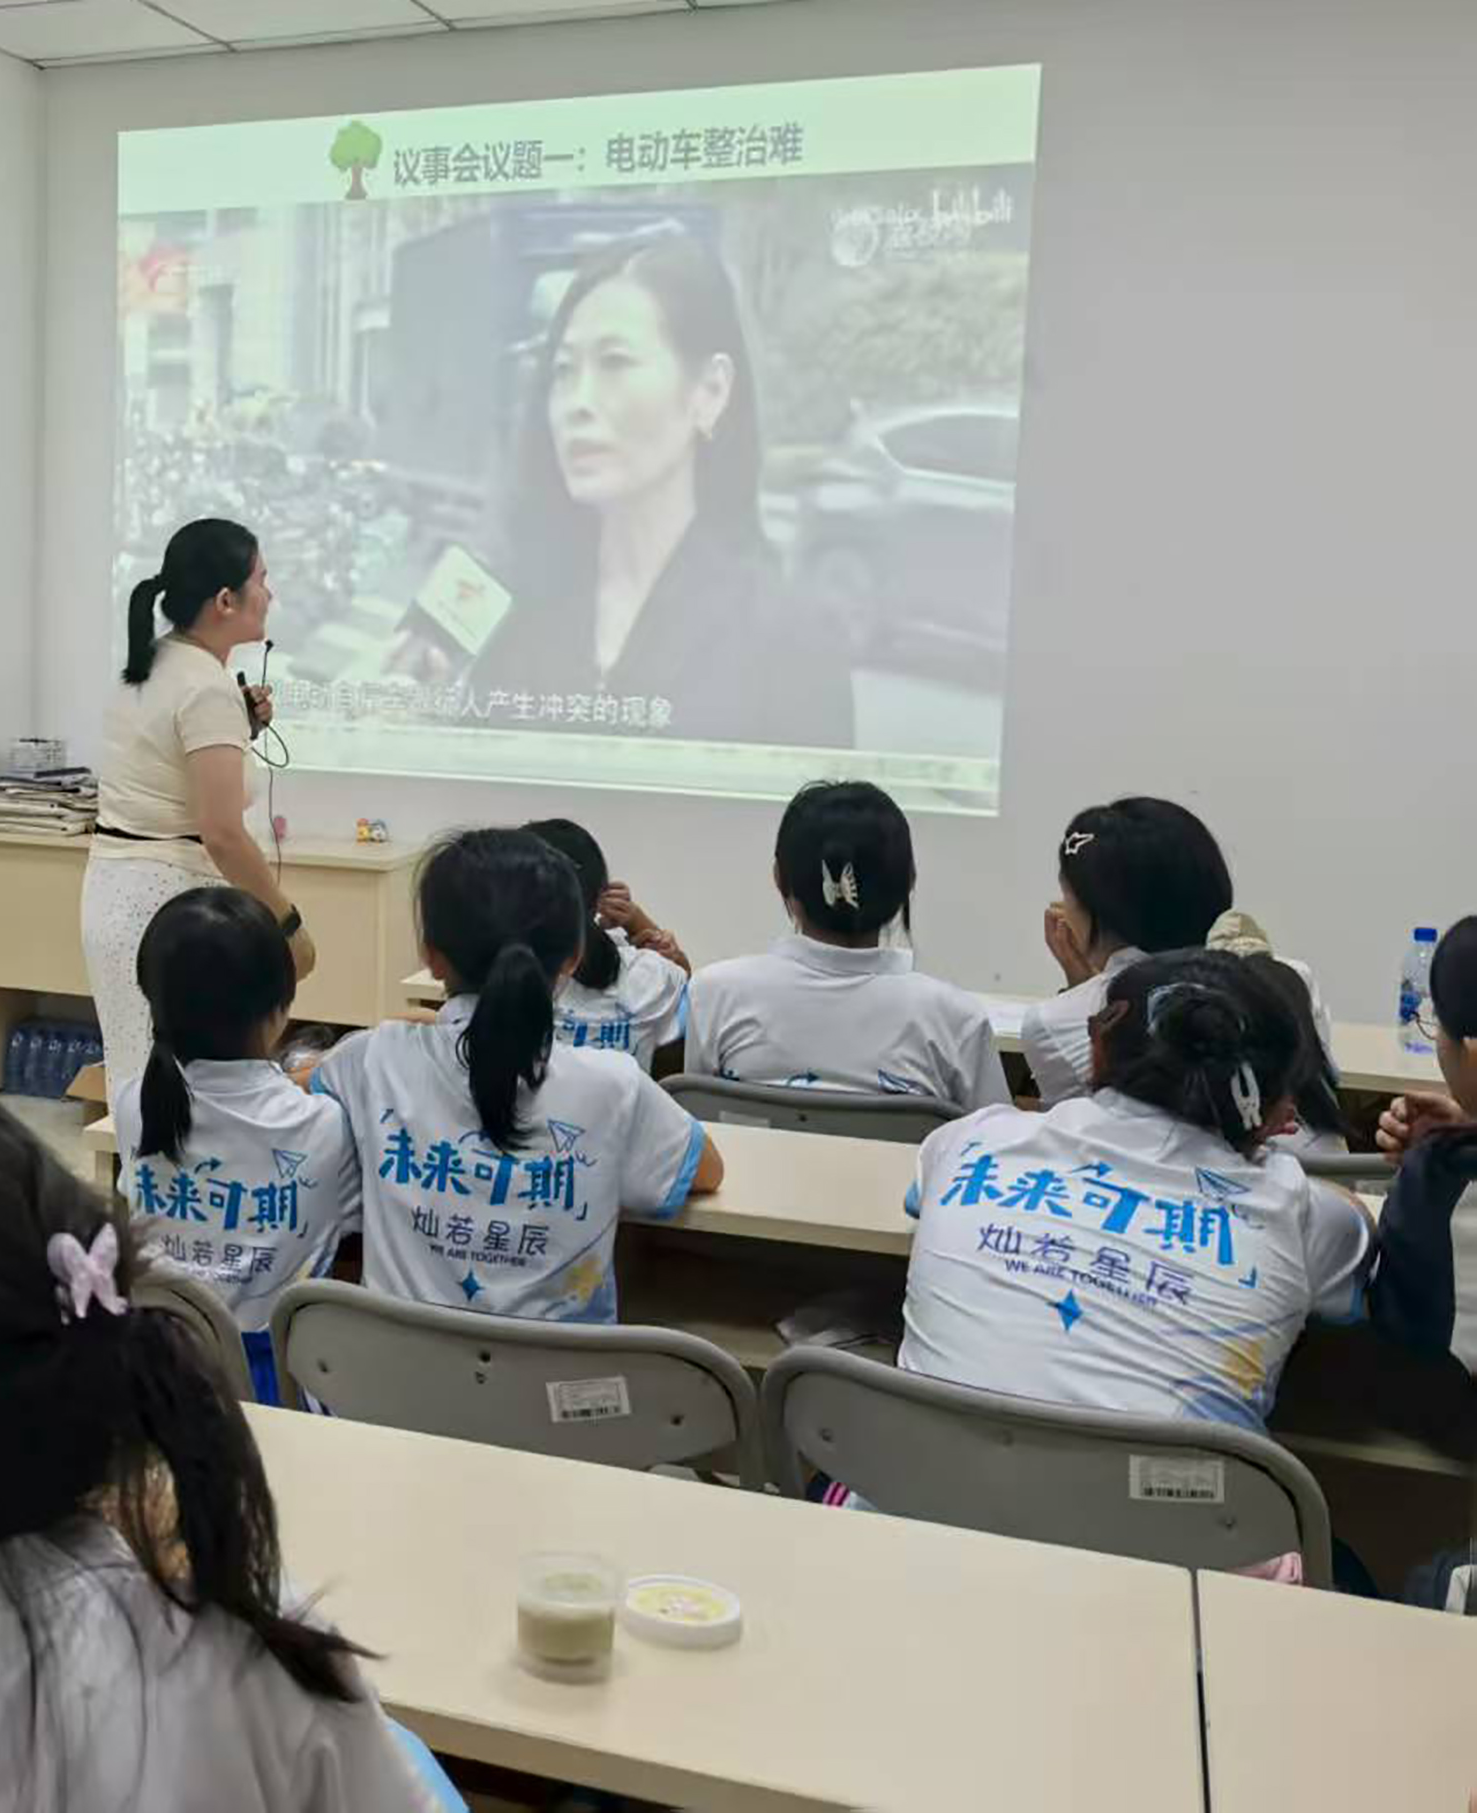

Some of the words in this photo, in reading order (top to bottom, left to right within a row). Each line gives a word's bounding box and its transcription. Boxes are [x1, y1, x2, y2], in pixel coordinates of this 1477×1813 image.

[411, 1205, 550, 1256] 灿若星辰
[161, 1234, 278, 1280] 灿若星辰
[977, 1223, 1195, 1306] 灿若星辰
[1005, 1258, 1031, 1275] WE
